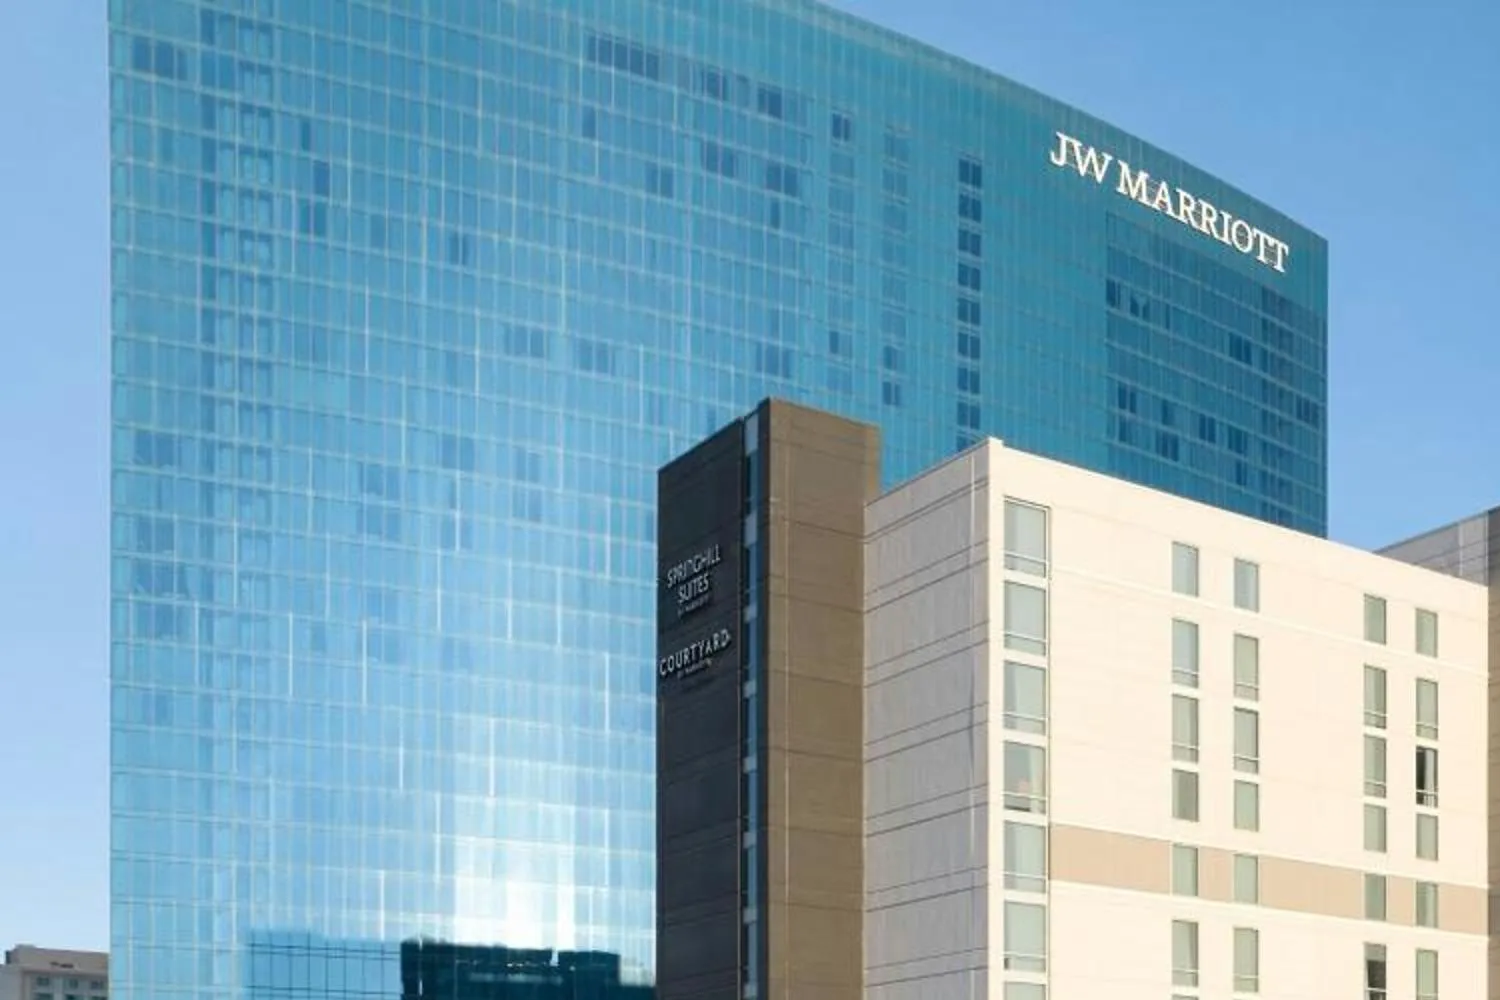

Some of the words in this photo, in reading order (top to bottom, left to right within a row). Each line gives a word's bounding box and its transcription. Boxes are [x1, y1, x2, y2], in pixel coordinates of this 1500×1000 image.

[1050, 131, 1113, 184] JW
[1115, 159, 1290, 273] MARRIOTT
[659, 628, 732, 677] COURTYARD
